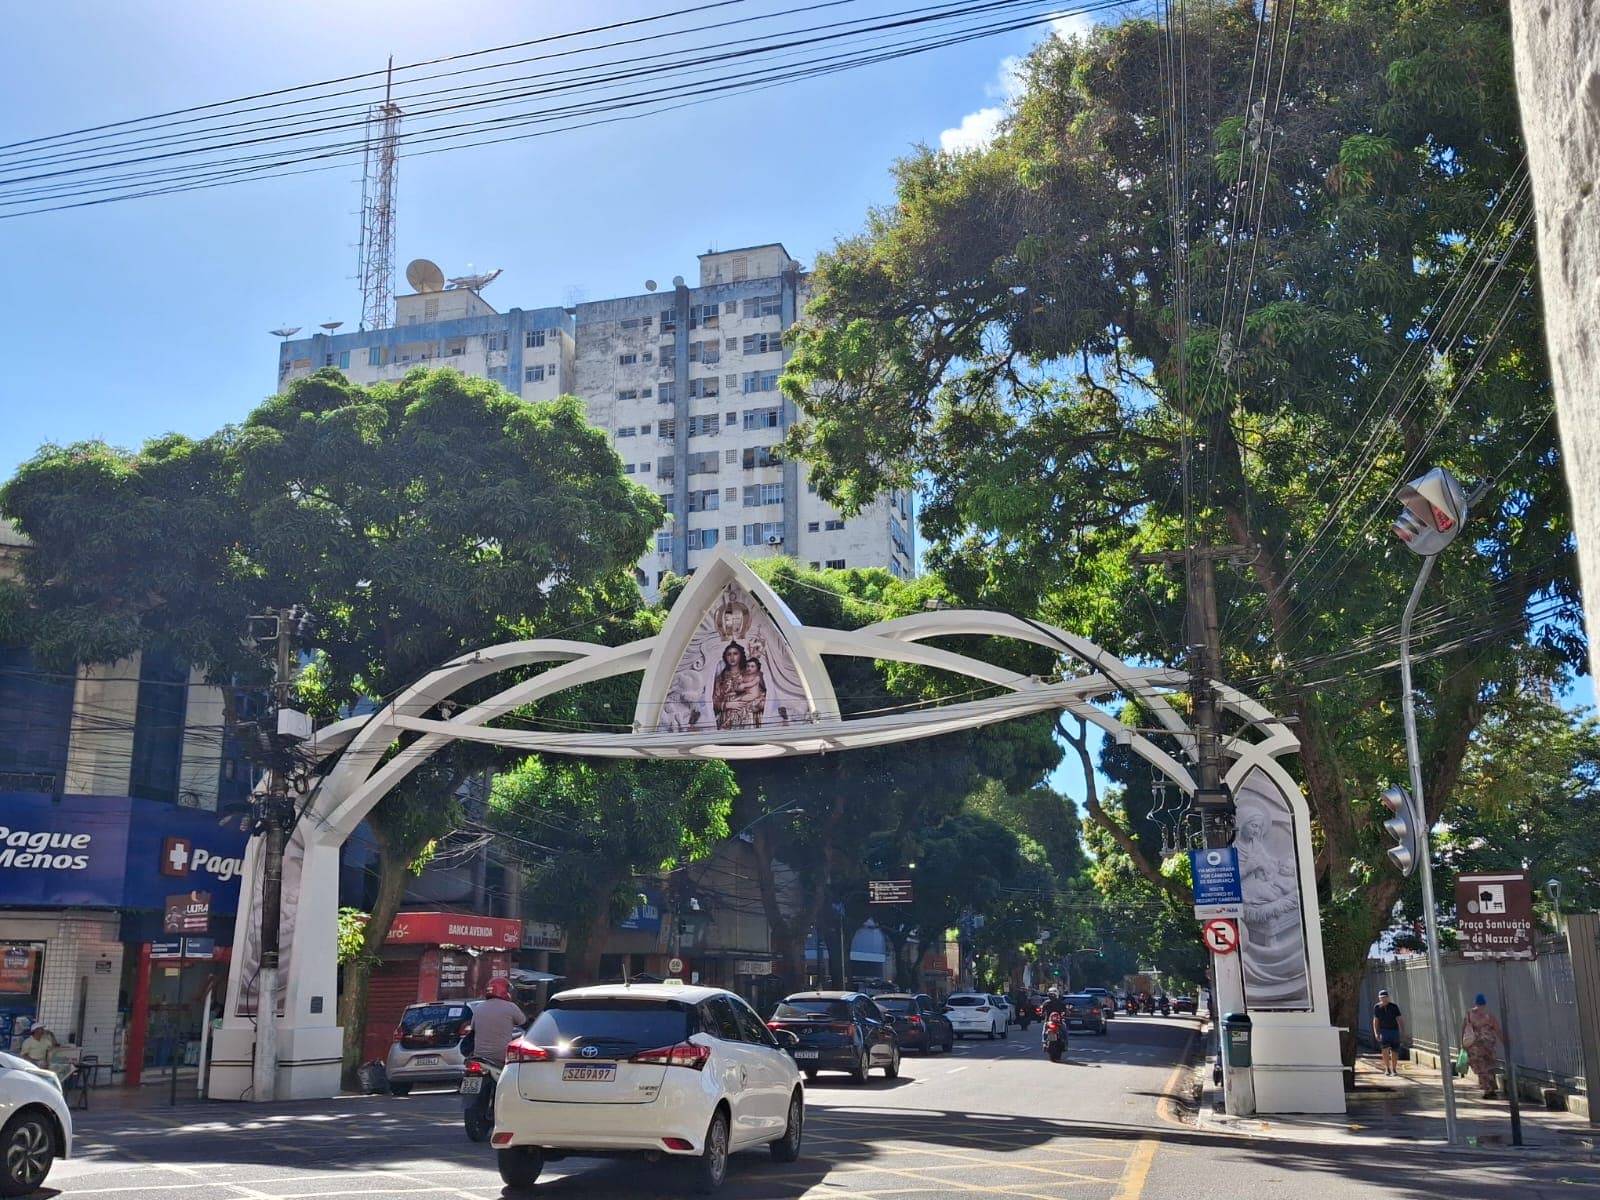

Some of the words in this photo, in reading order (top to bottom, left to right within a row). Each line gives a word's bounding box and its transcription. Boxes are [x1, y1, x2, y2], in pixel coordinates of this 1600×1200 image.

[1459, 920, 1484, 931] Praça
[1485, 919, 1531, 929] Santuário
[567, 1068, 611, 1080] SZG9A97
